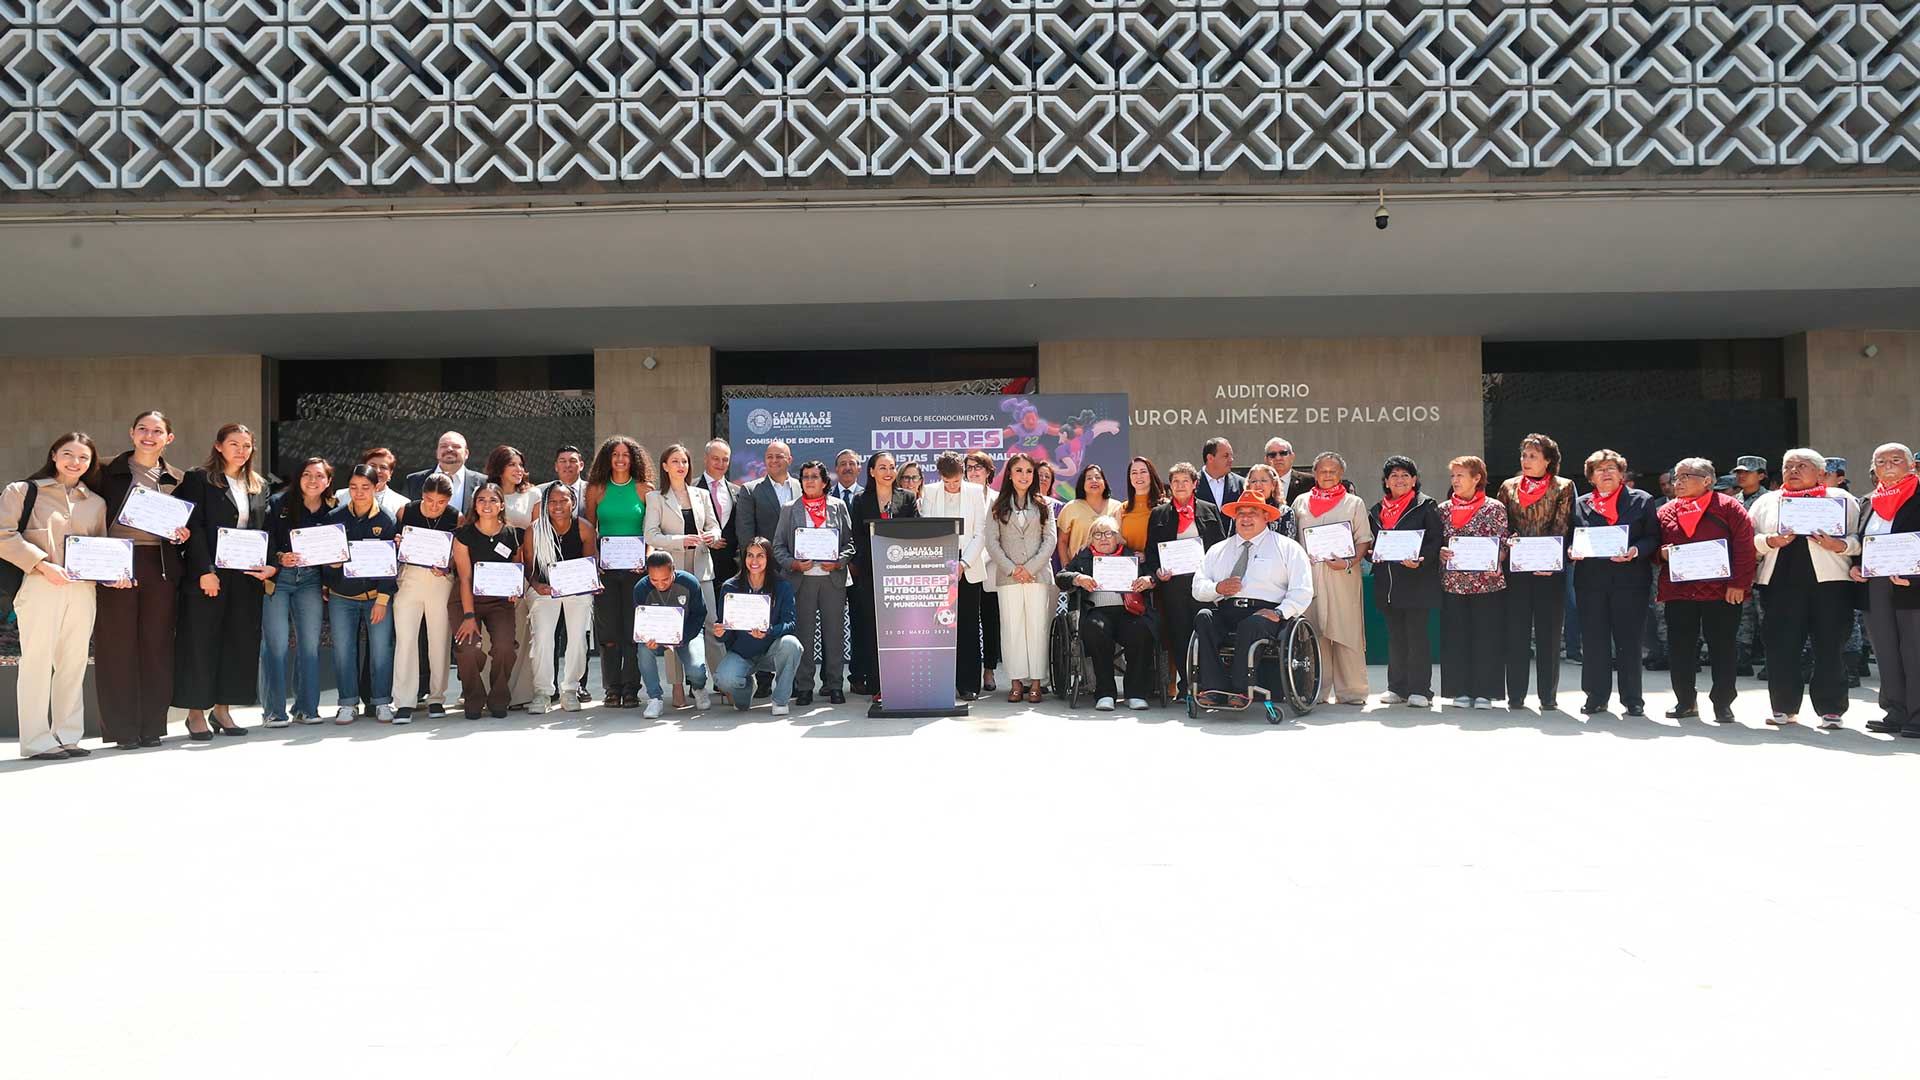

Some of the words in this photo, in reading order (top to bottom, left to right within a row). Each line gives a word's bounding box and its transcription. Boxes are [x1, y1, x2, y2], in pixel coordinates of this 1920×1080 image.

[1216, 384, 1309, 398] AUDITORIO
[1216, 403, 1298, 424] JIMÉNEZ
[1306, 408, 1329, 423] DE
[1338, 406, 1440, 422] PALACIOS
[876, 431, 1000, 448] MUJERES
[1023, 436, 1039, 446] 22
[884, 586, 948, 594] FUTBOLISTAS
